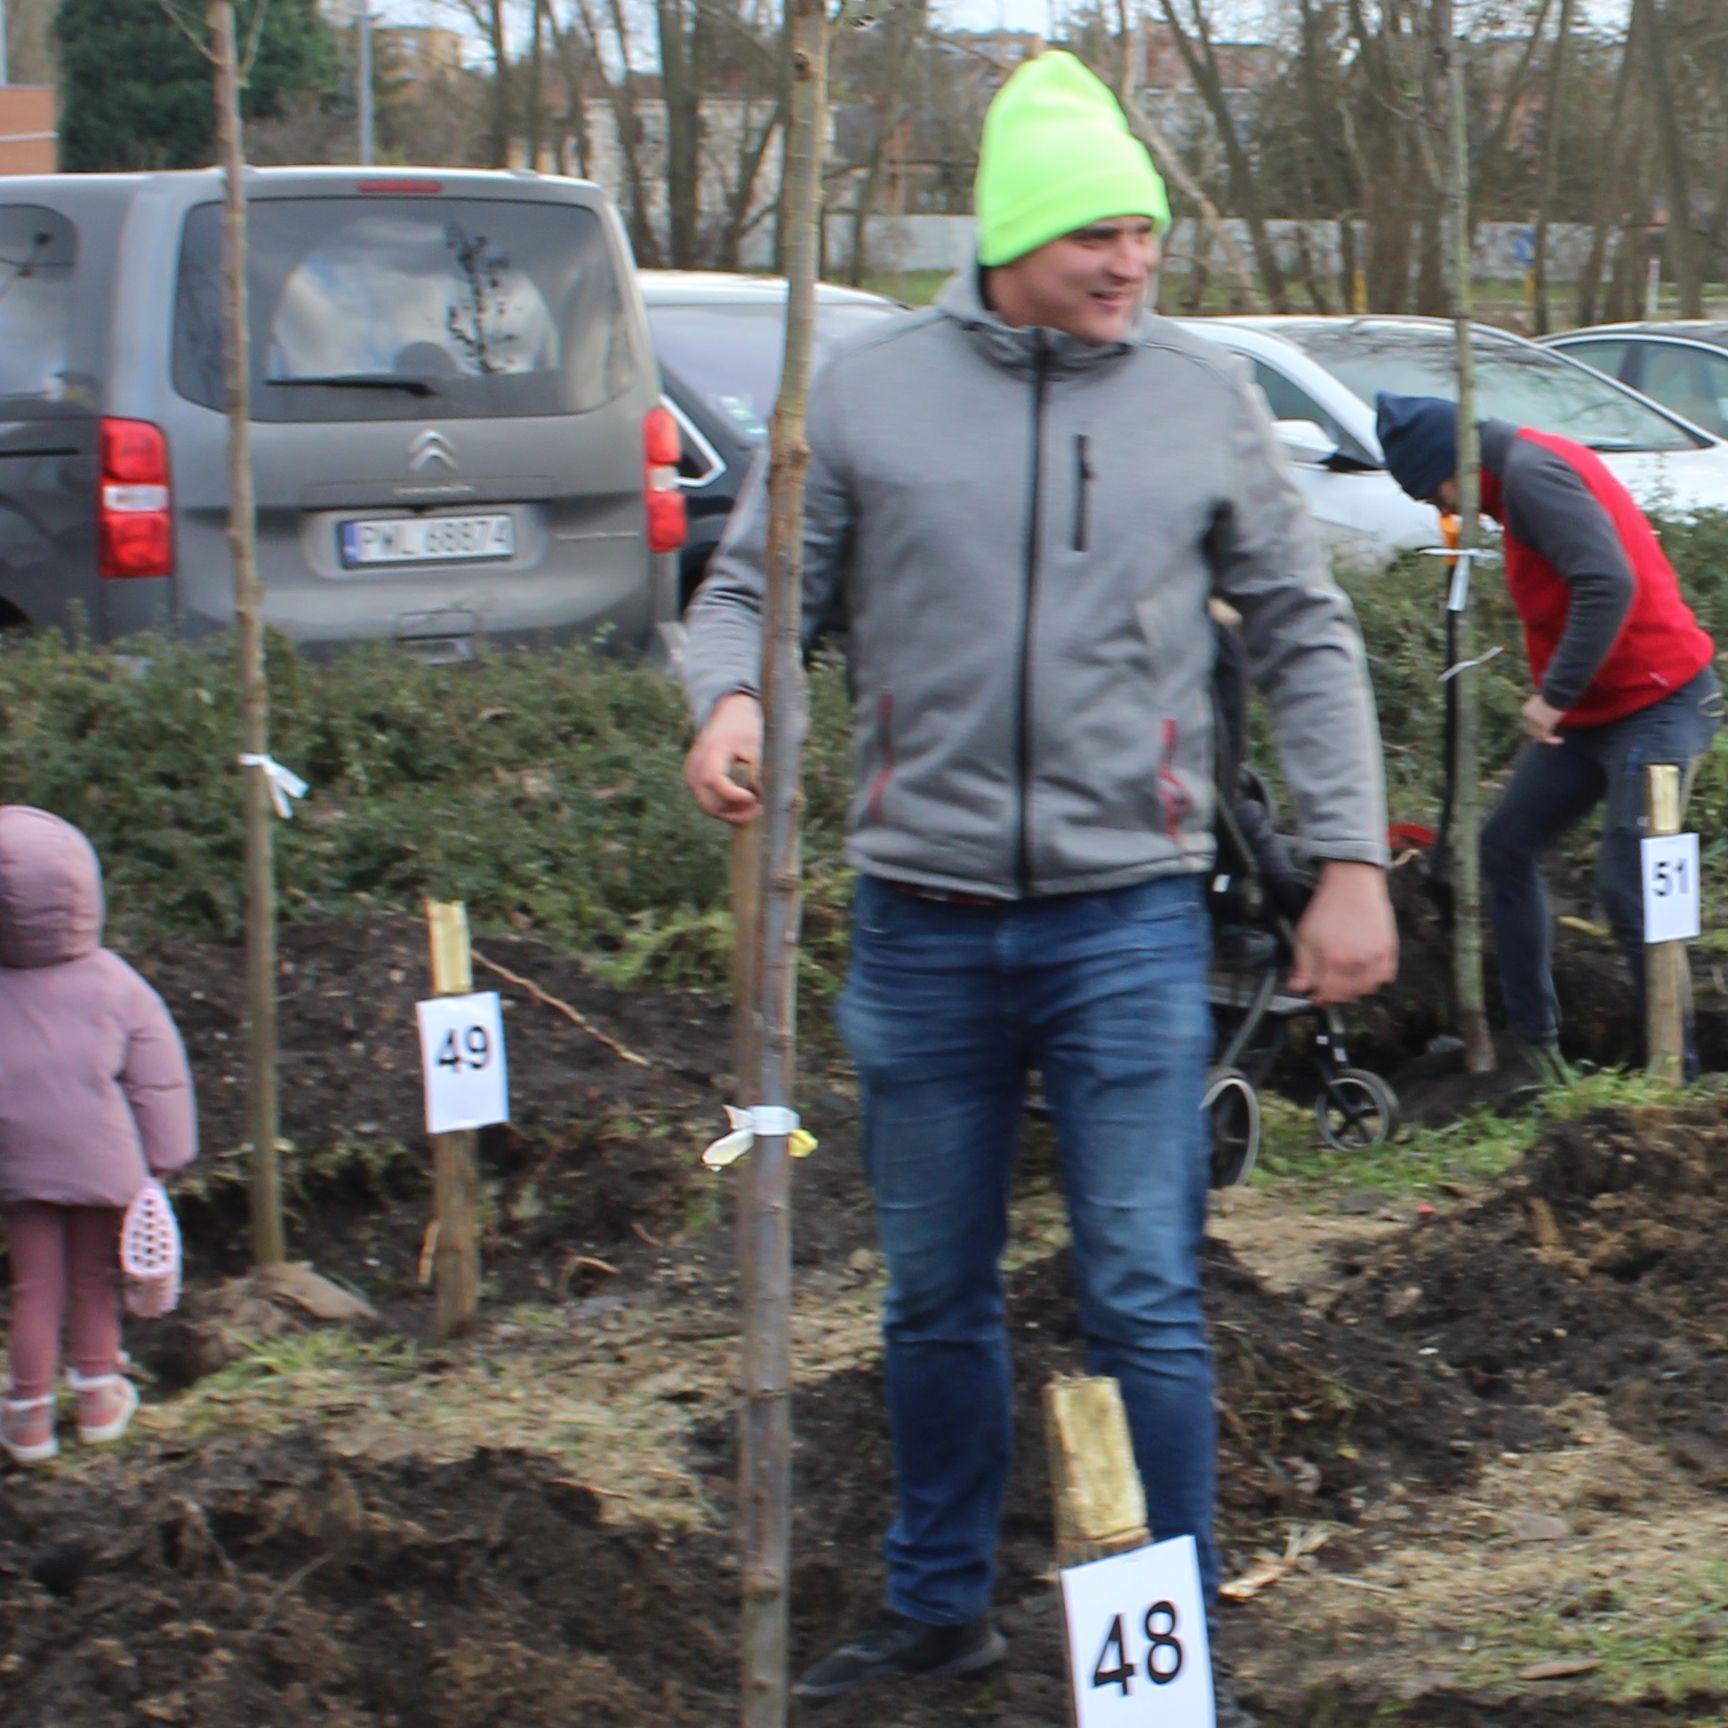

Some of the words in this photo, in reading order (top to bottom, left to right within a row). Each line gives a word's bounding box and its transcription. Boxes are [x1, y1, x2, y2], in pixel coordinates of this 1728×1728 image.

[1652, 858, 1688, 898] 51
[434, 1025, 489, 1073] 49
[1093, 1599, 1183, 1696] 48
